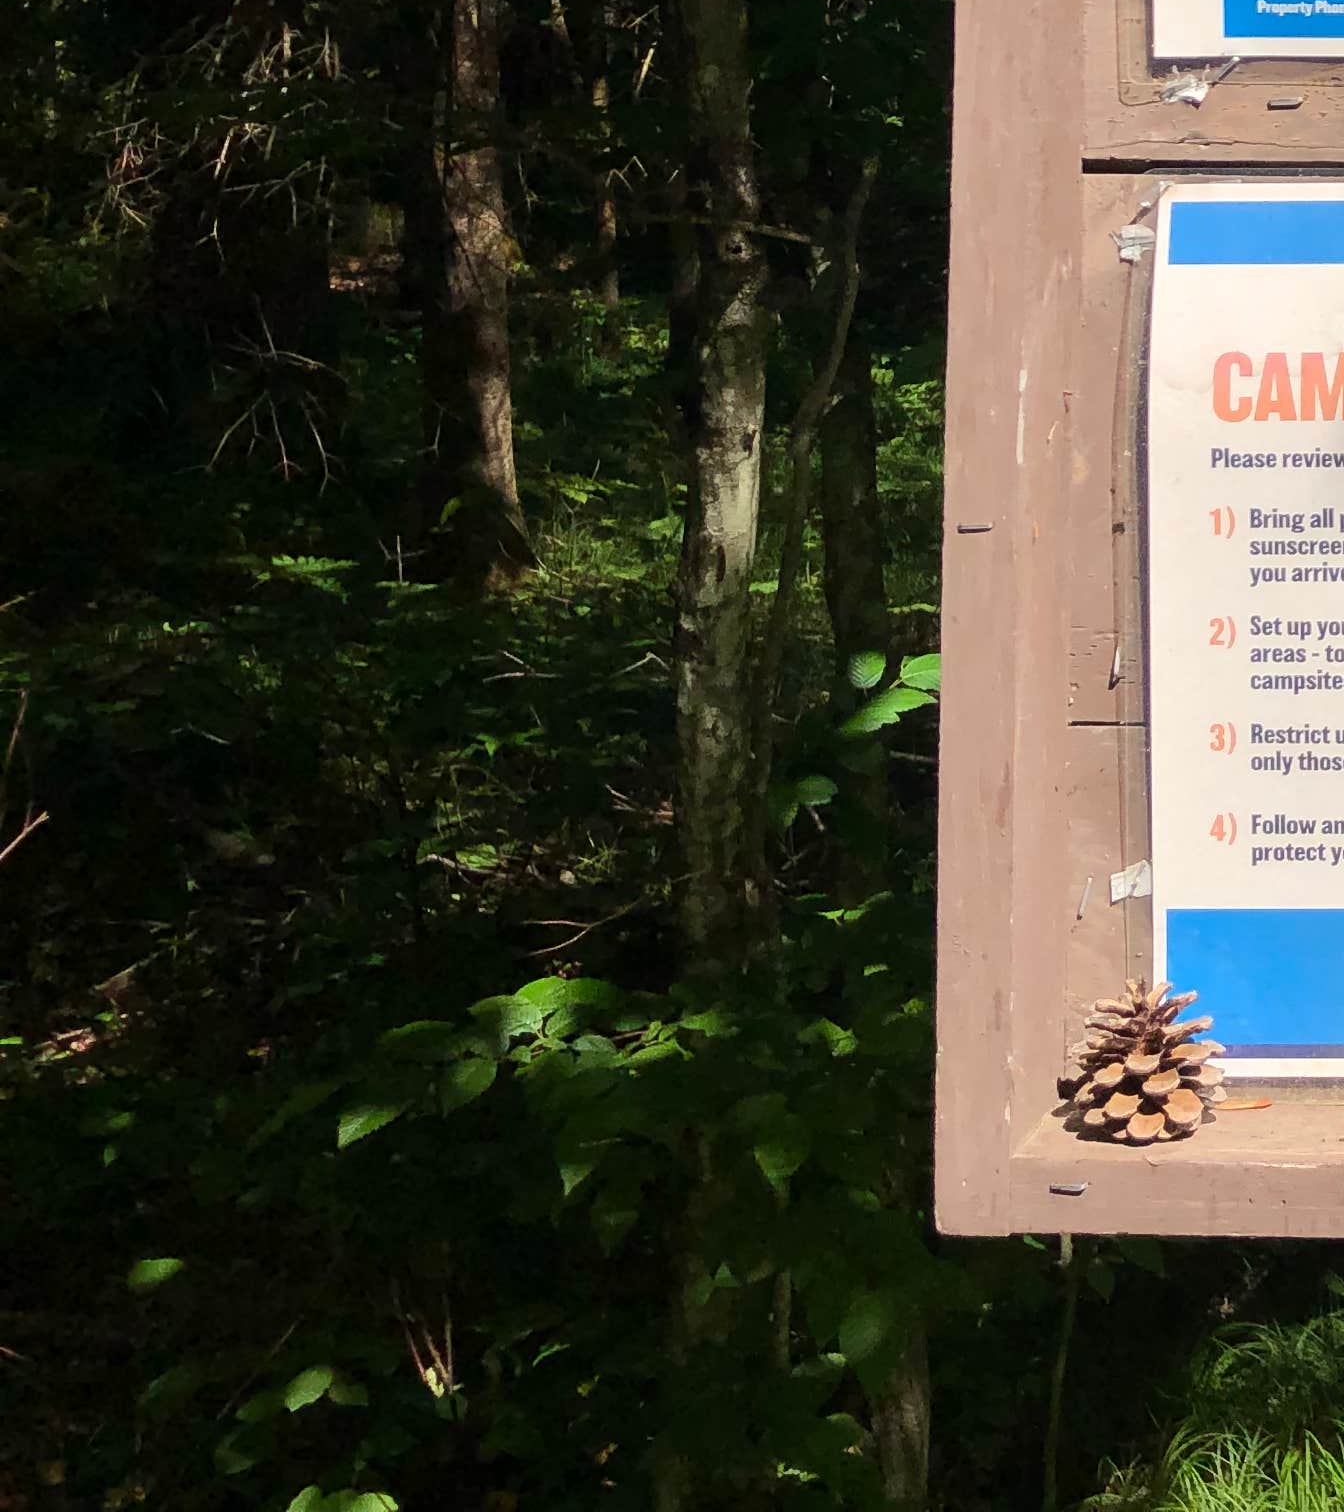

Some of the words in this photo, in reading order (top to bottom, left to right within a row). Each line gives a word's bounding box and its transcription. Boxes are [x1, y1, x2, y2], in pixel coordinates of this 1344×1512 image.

[1257, 0, 1313, 16] Property
[1212, 448, 1276, 468] Please
[1209, 508, 1236, 540] 1)
[1251, 509, 1304, 533] Bring
[1311, 508, 1333, 528] all
[1211, 816, 1235, 844] 4)
[1252, 815, 1316, 834] Follow
